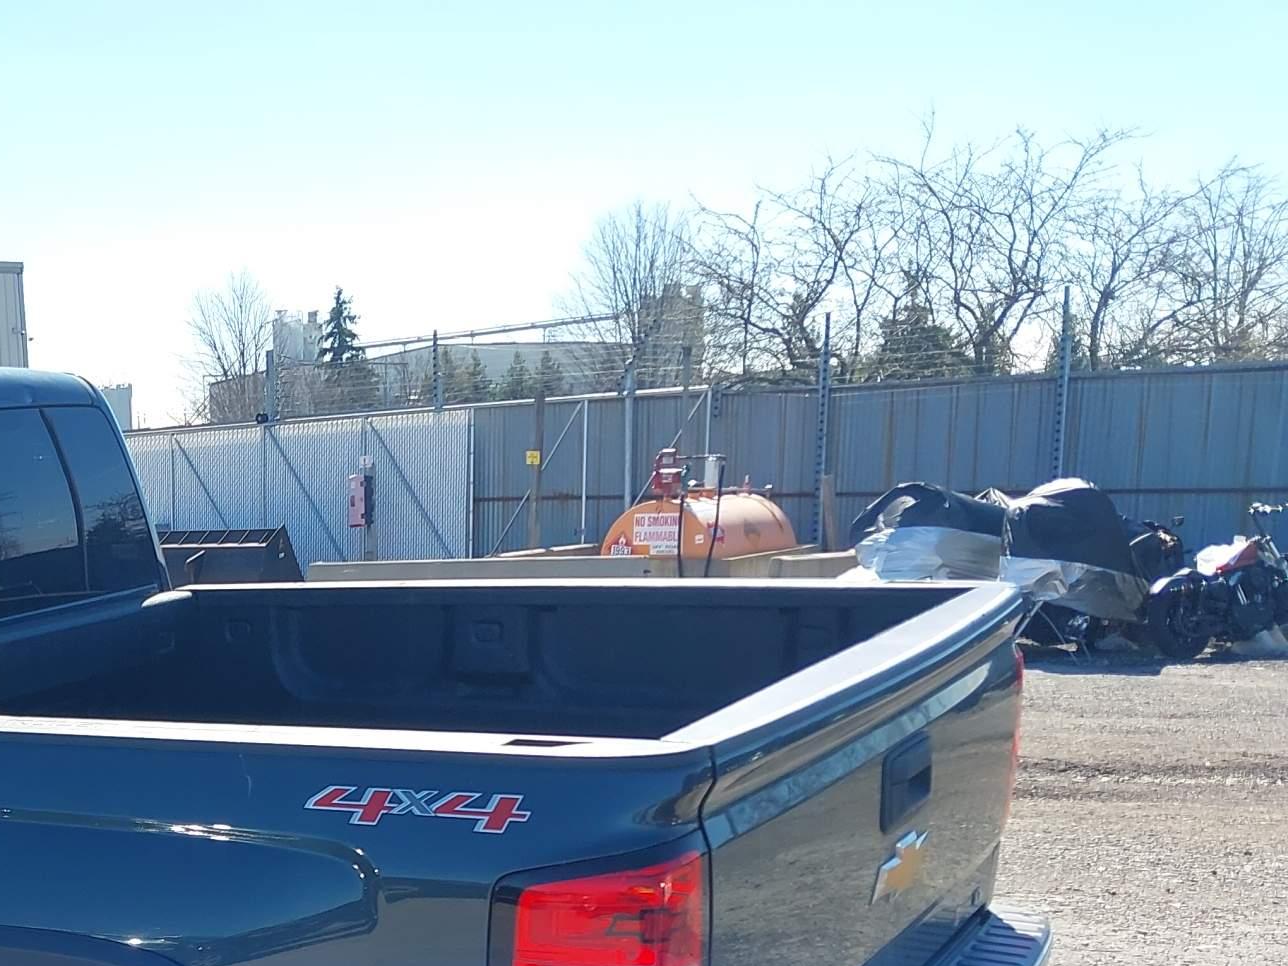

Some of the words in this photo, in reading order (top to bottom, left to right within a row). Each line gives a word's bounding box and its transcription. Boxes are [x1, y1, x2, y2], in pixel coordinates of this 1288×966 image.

[635, 516, 646, 527] NO
[647, 516, 680, 527] SMOKIN
[634, 530, 679, 542] FLAMMABL
